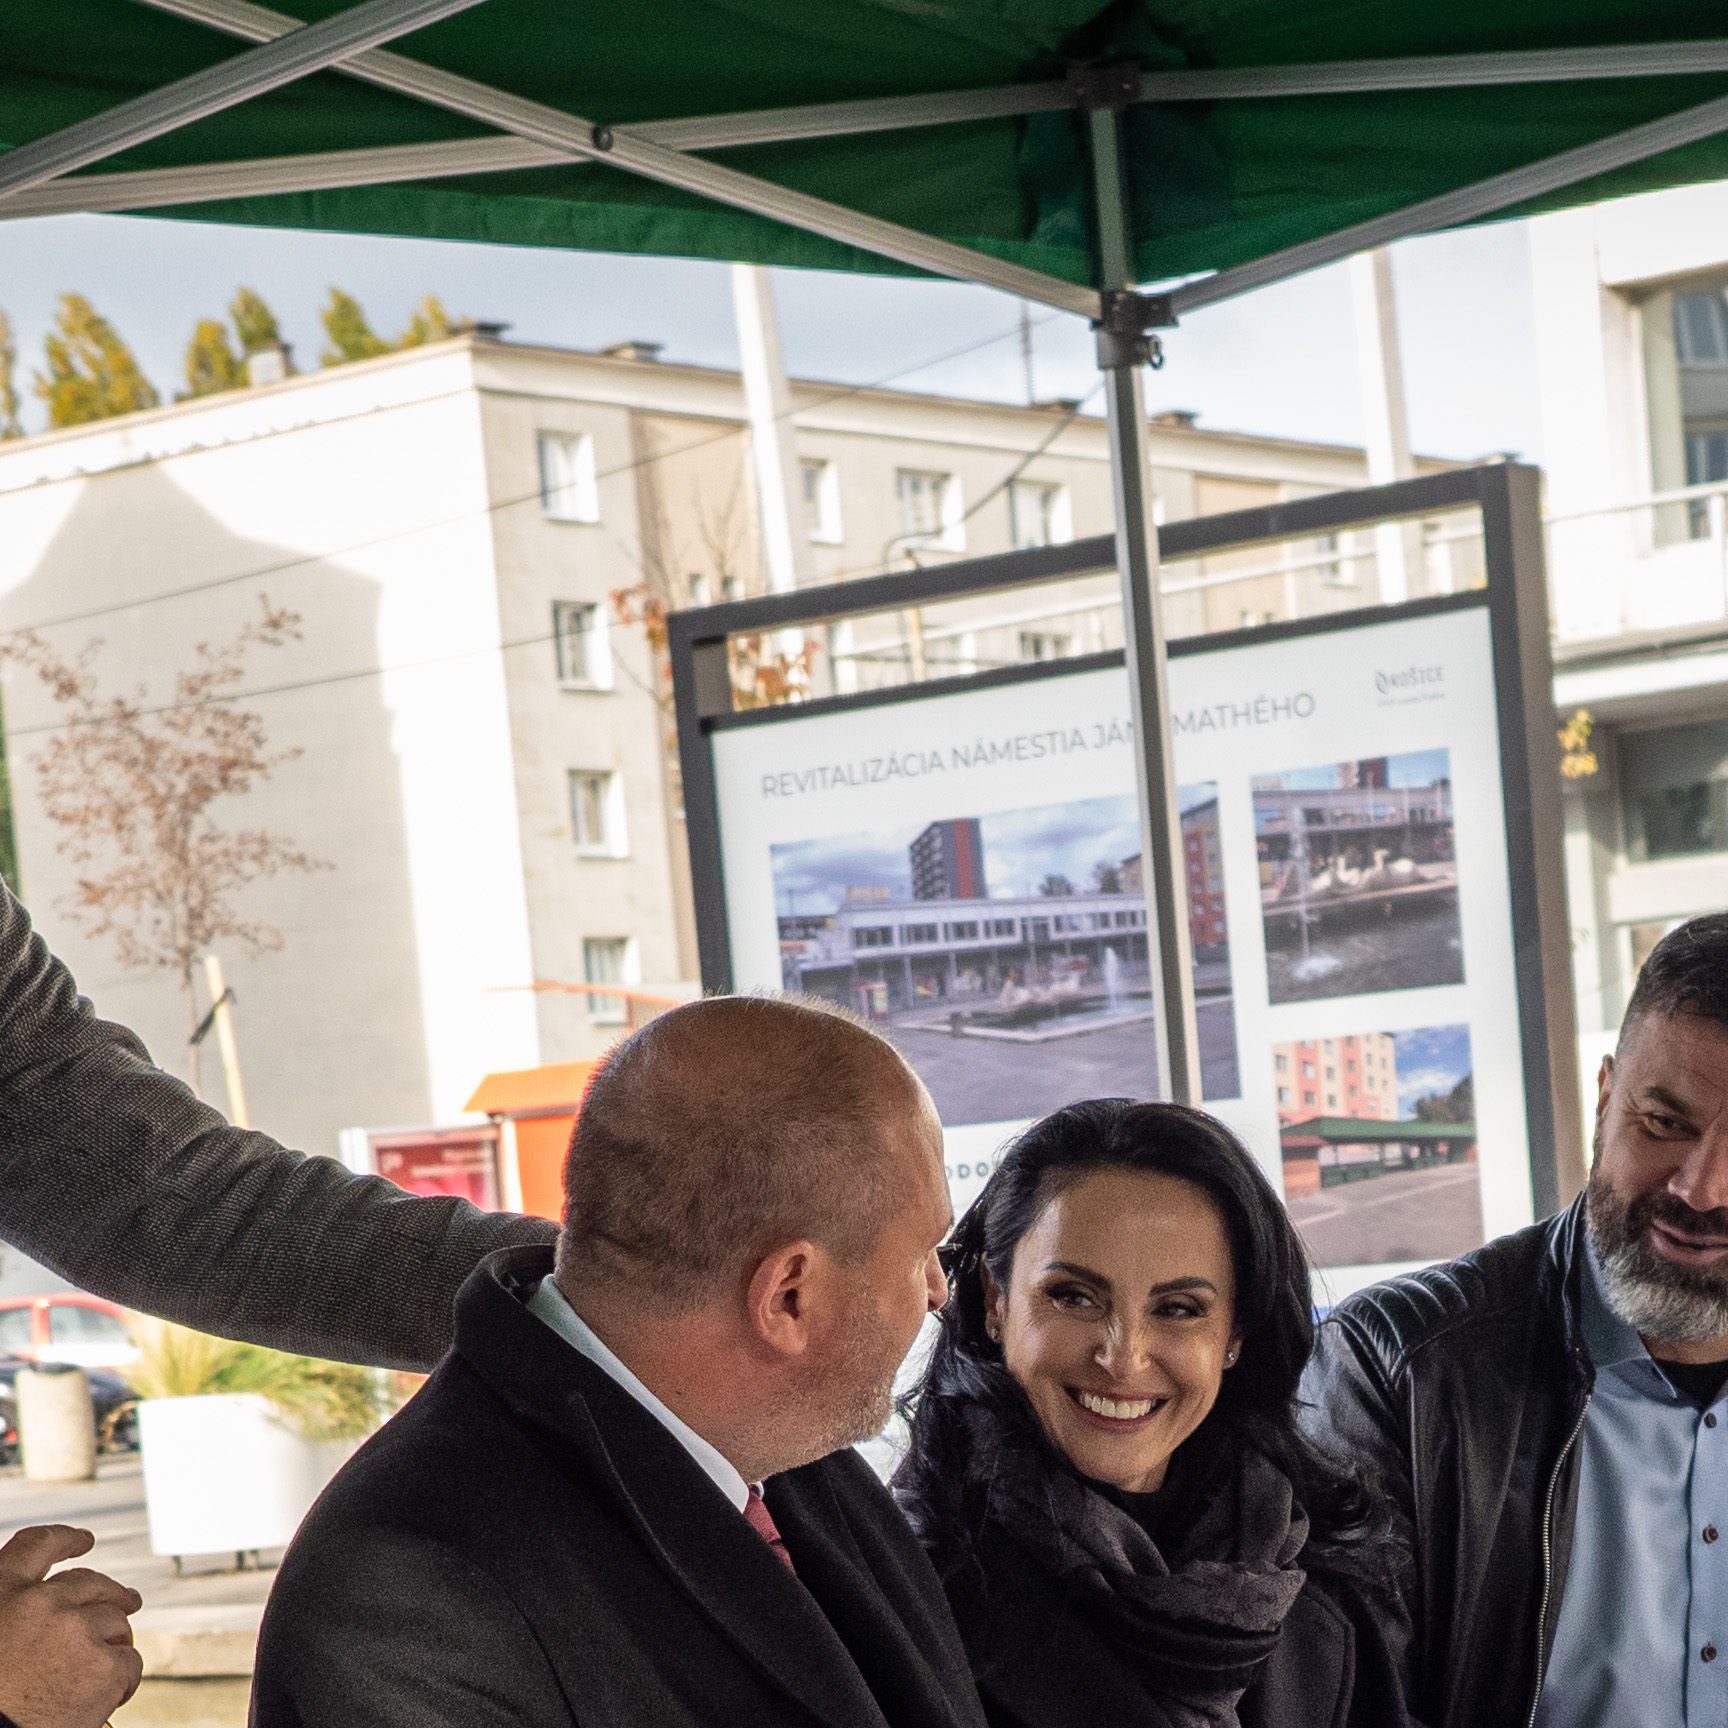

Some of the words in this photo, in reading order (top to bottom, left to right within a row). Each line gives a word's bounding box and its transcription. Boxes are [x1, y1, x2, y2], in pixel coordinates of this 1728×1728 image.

[1388, 666, 1445, 690] KOŠICE
[761, 749, 945, 799] REVITALIZÁCIA
[952, 727, 1086, 771] NÁMESTIA
[1092, 716, 1134, 751] JÁN
[1172, 692, 1316, 737] MATHÉHO
